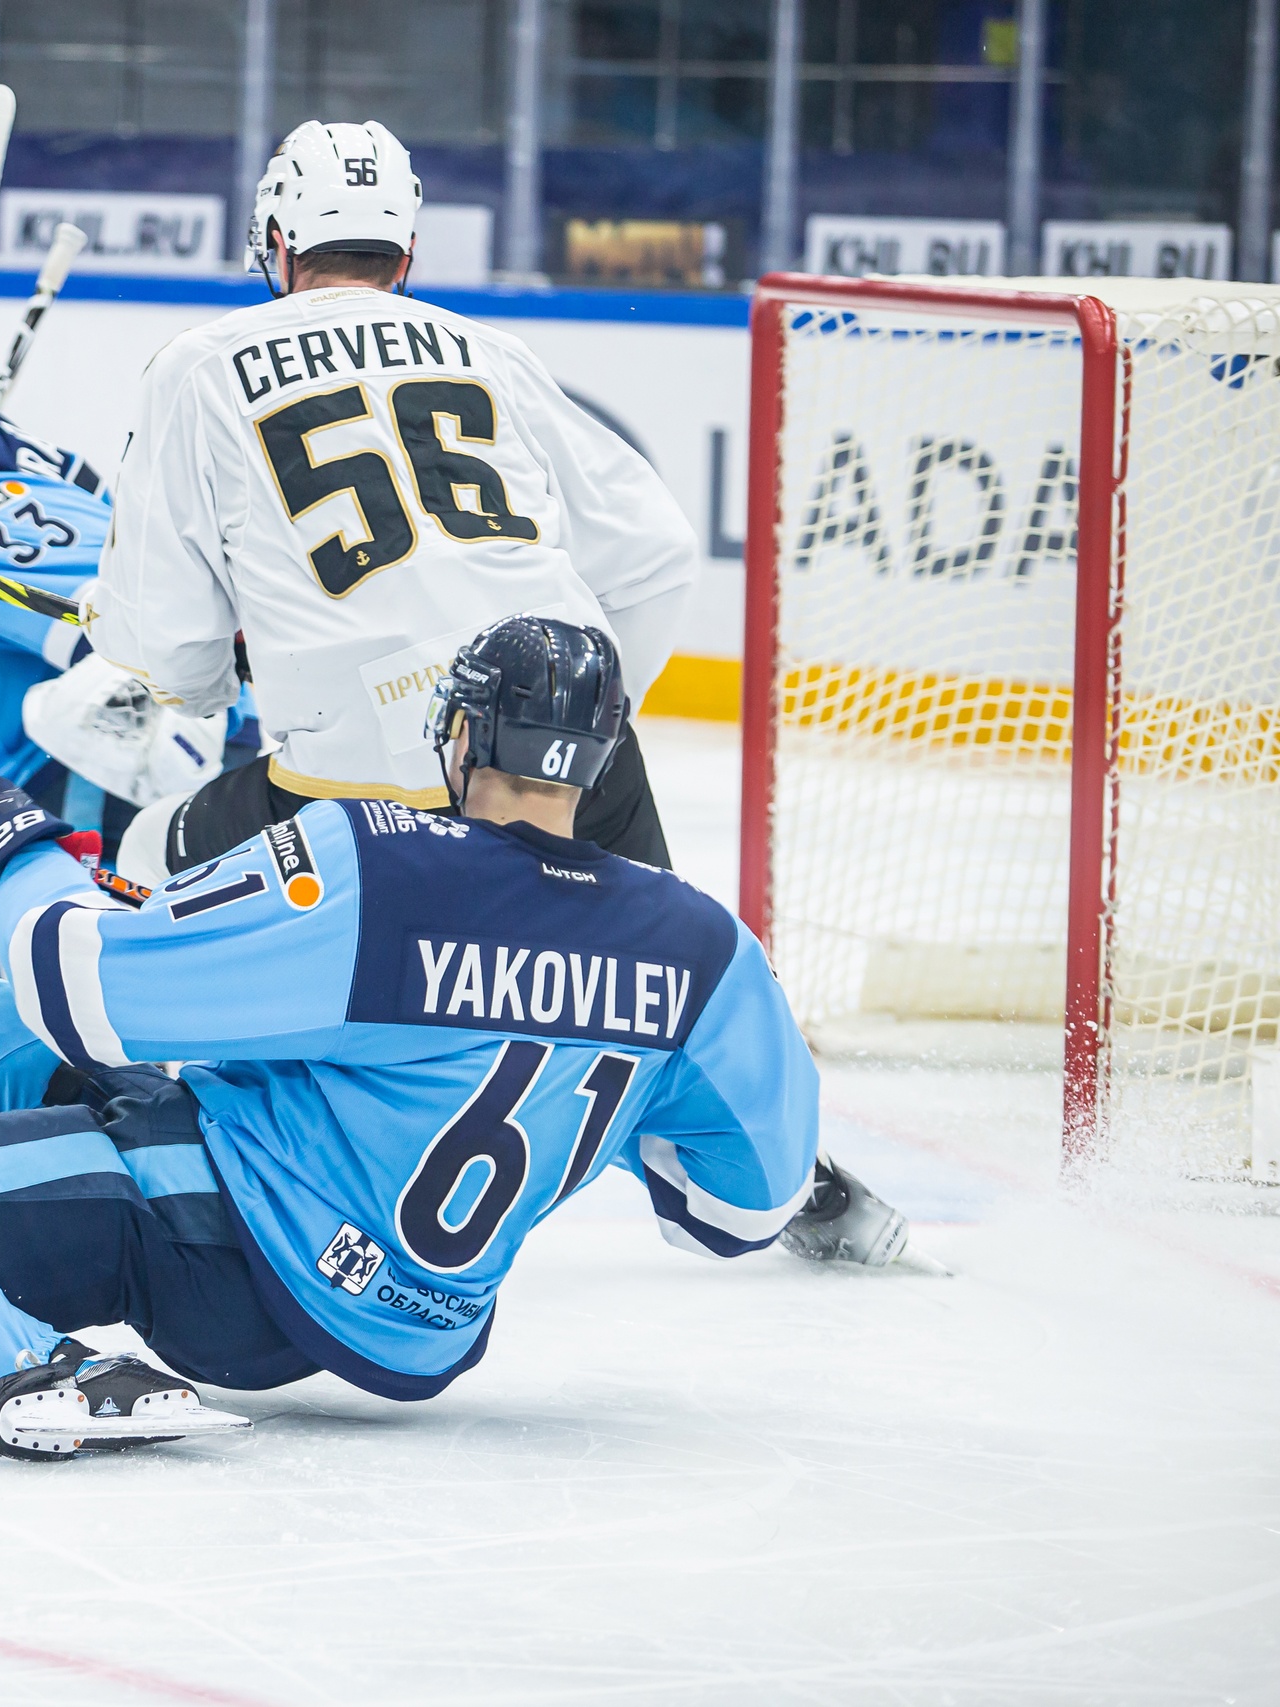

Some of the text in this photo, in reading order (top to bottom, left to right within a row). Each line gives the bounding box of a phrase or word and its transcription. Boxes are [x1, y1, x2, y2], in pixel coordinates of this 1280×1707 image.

[344, 158, 377, 187] 56
[823, 236, 992, 276] KHLRU
[1056, 240, 1217, 281] KHLRU
[232, 321, 473, 404] CERVENY
[253, 377, 541, 601] 56
[374, 658, 456, 706] ПРИМ
[541, 739, 577, 779] 61
[387, 801, 418, 833] СИБ
[542, 862, 597, 884] LUTCH
[417, 939, 691, 1040] YAKOVLEV
[393, 1040, 642, 1274] 61
